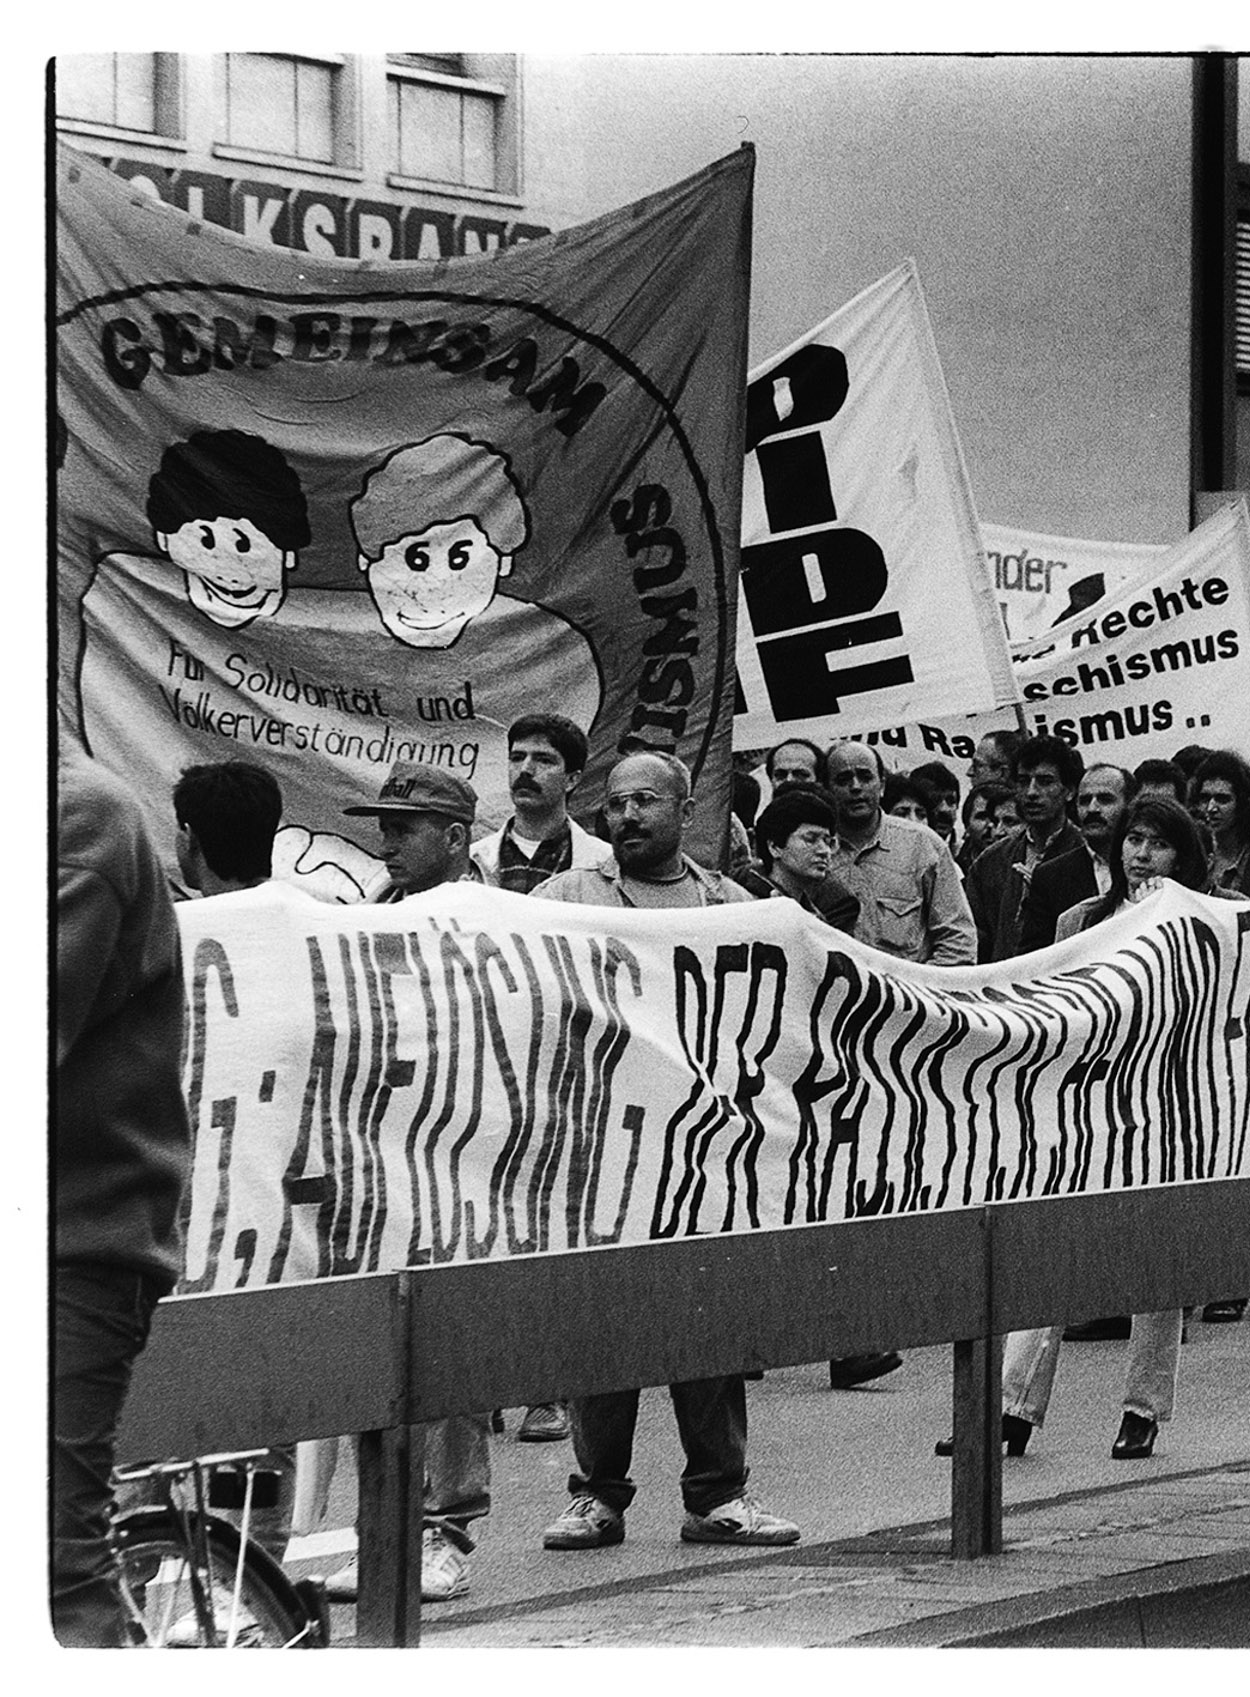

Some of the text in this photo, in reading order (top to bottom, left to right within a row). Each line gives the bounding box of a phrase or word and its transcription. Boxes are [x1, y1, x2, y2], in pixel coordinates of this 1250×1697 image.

[103, 312, 607, 437] GEMEINSAM
[225, 653, 389, 717] Solidarität
[418, 681, 476, 721] und
[266, 917, 643, 1285] AUFLÖSUNG
[650, 942, 788, 1240] DER
